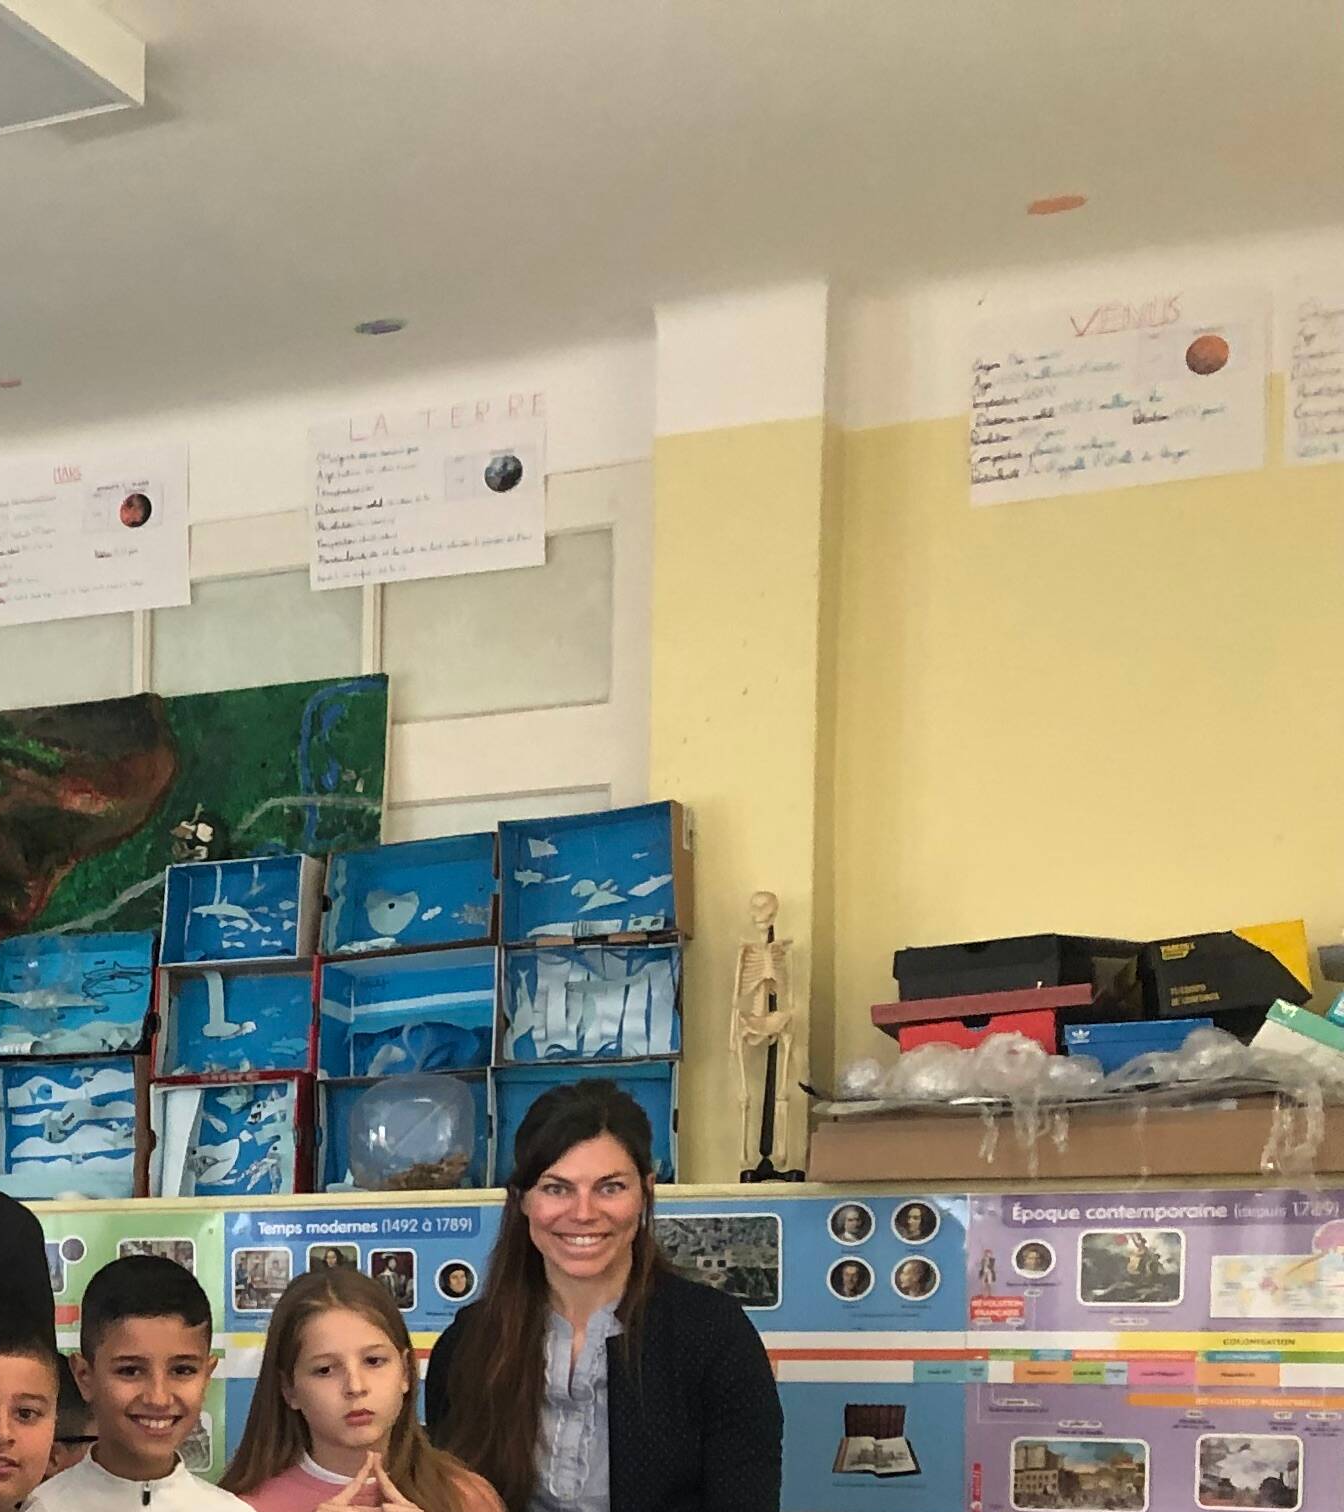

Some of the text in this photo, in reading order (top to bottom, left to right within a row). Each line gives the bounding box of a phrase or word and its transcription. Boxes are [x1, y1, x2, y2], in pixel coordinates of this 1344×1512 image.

[1070, 292, 1182, 337] VENUS
[348, 393, 546, 442] LA TERRE
[258, 1217, 473, 1236] Temps modernes (1492 à 1789)
[1012, 1204, 1081, 1223] Époque
[1085, 1204, 1228, 1221] contemporaine
